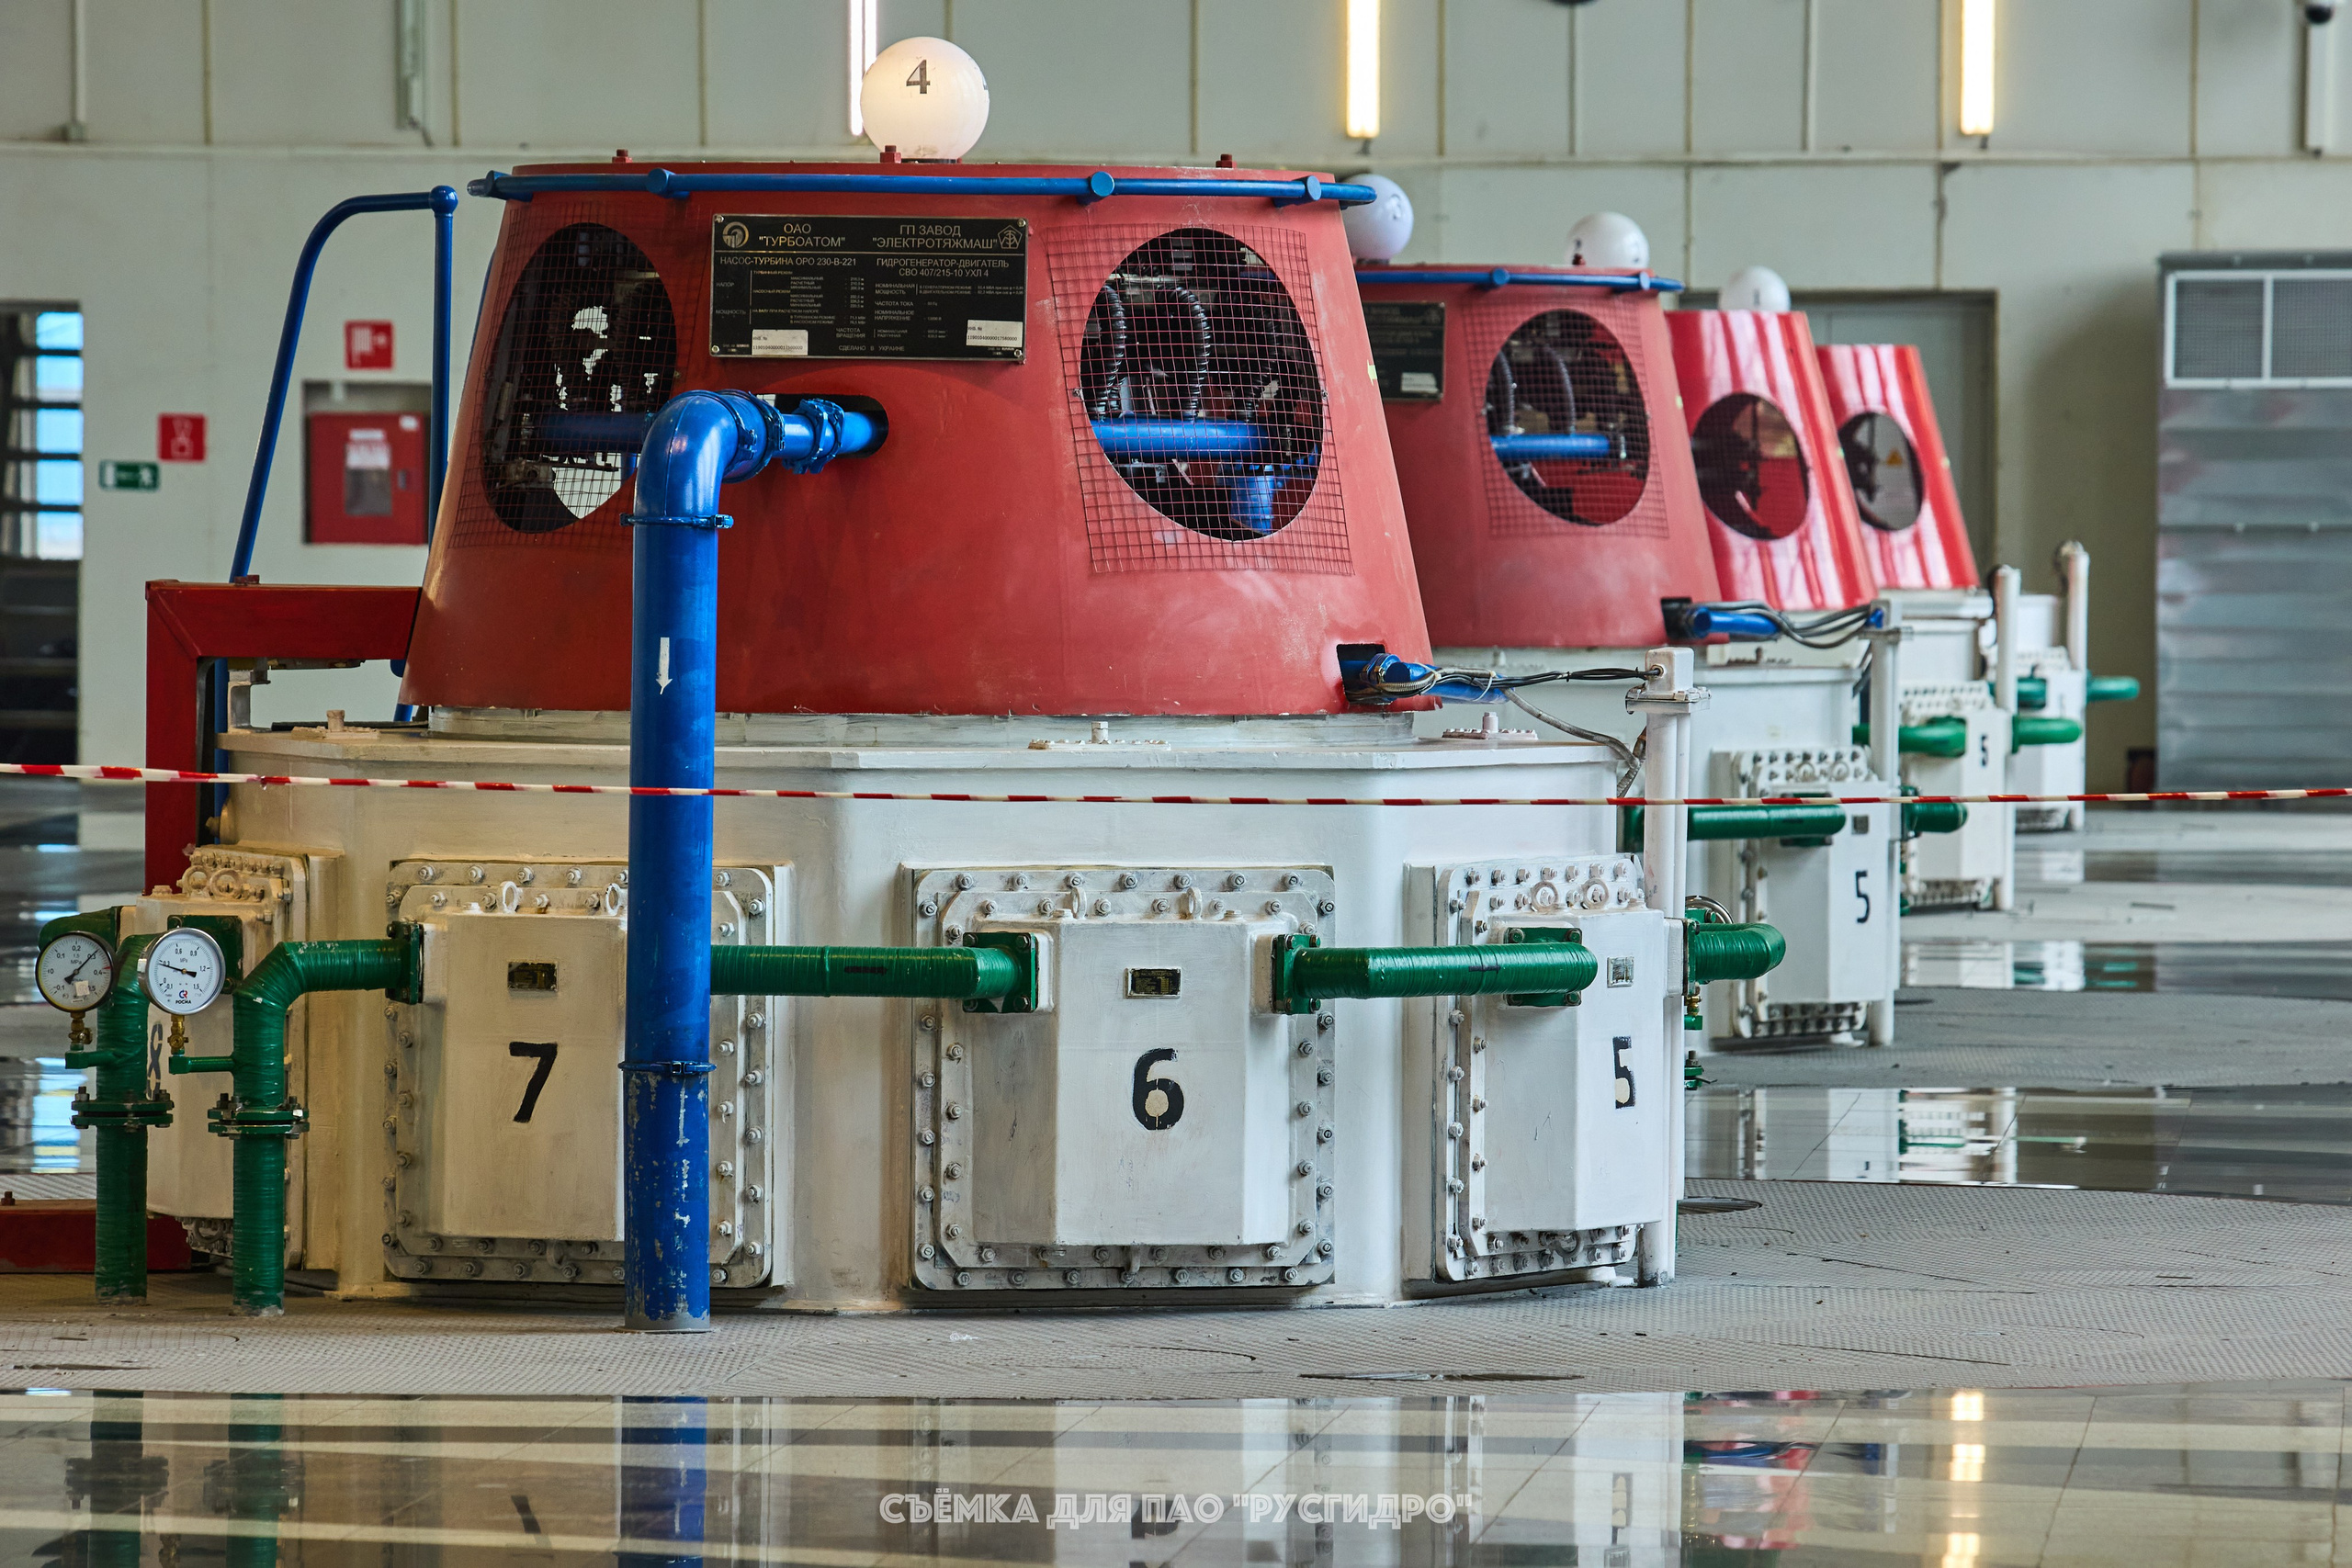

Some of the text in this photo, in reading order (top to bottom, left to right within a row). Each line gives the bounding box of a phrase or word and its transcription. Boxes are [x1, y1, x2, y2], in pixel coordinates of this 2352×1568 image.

[906, 59, 931, 95] 4
[784, 223, 812, 234] ОАО
[899, 224, 962, 238] ГП ЗАВОД
[758, 235, 846, 248] "ТУРБОАТОМ"
[872, 236, 998, 250] "ЭЛЕКТРОТЯЖМАШ"
[719, 256, 857, 266] НАСОС-ТУРБИНА ОРО 230-В-221
[876, 257, 1010, 268] ГИДРОГЕНЕРАТОР-ДВИГАТЕЛЬ
[899, 267, 918, 276] СВО
[919, 268, 964, 277] 407/215-10
[965, 269, 982, 277] УХЛ
[1855, 869, 1871, 924] 5
[147, 1022, 164, 1101] 8
[1612, 1035, 1636, 1110] 5
[509, 1041, 559, 1123] 7
[1132, 1047, 1185, 1131] 6
